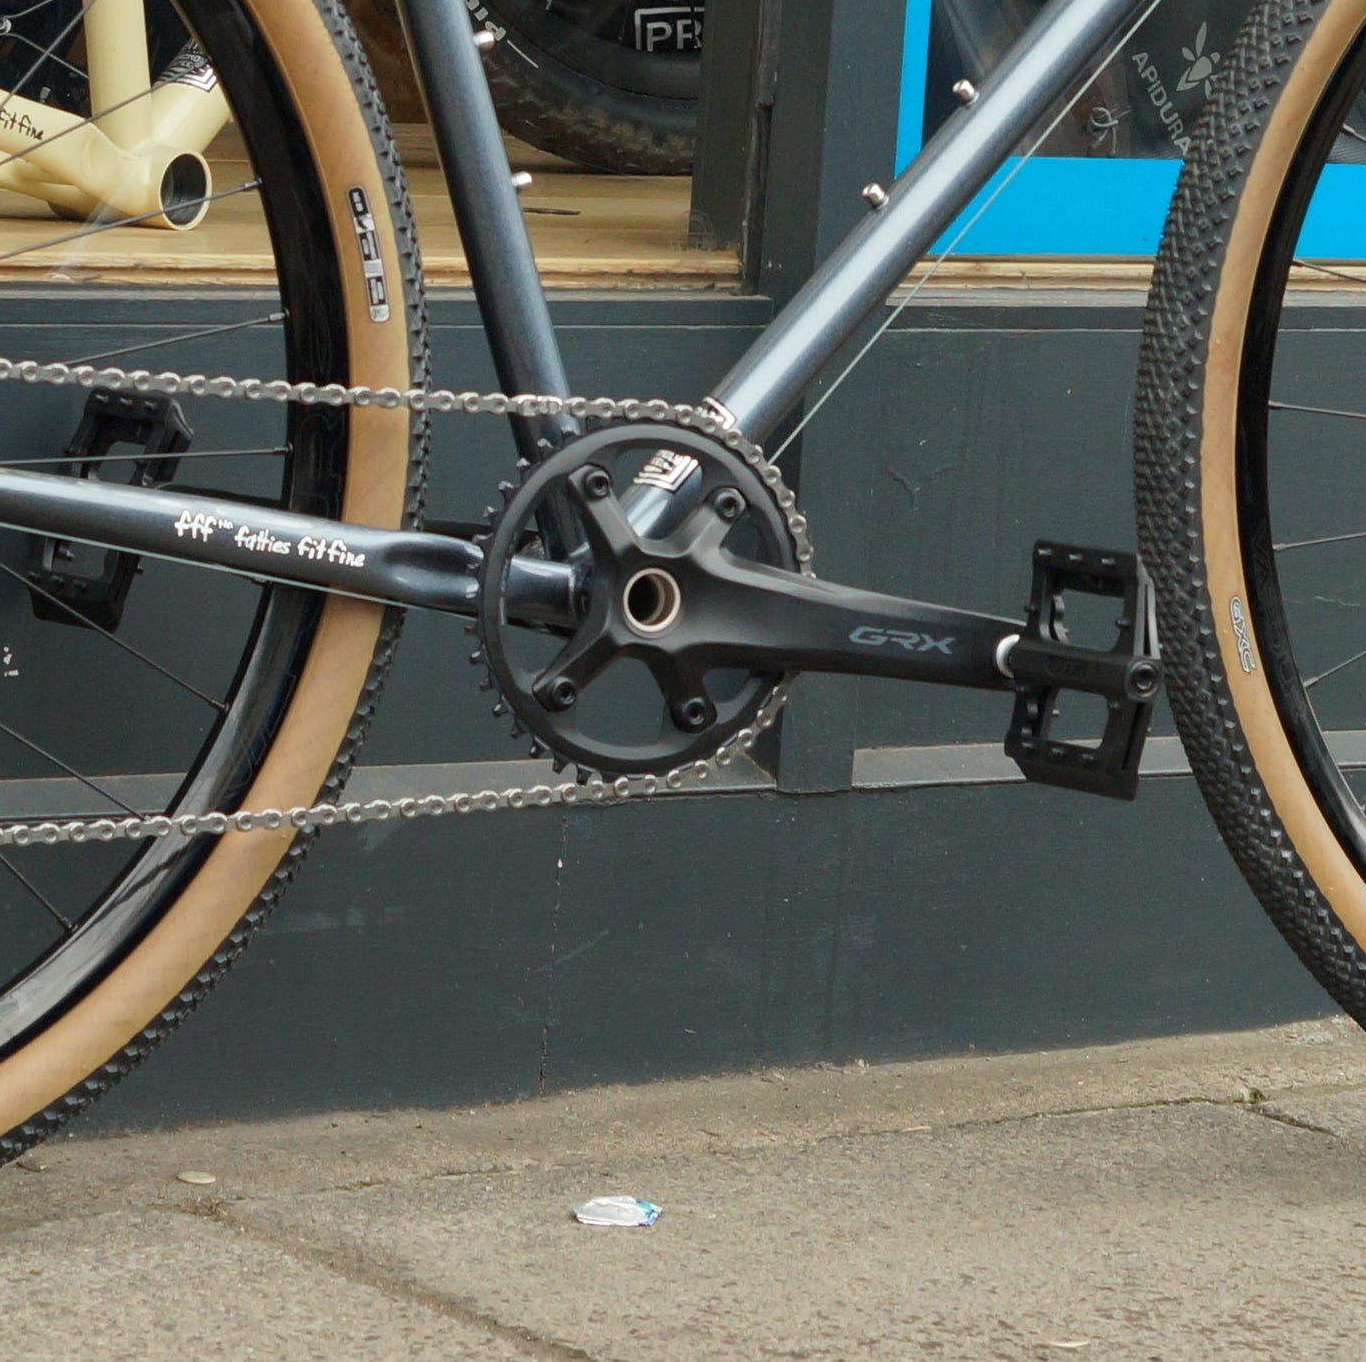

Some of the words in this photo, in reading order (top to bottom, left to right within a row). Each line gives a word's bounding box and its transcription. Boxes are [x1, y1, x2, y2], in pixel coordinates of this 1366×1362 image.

[1132, 52, 1191, 156] APIDURA
[234, 525, 291, 555] fatties
[297, 536, 327, 561] fit
[327, 539, 366, 568] fine
[849, 626, 956, 655] GRX
[1230, 596, 1257, 673] GXC
